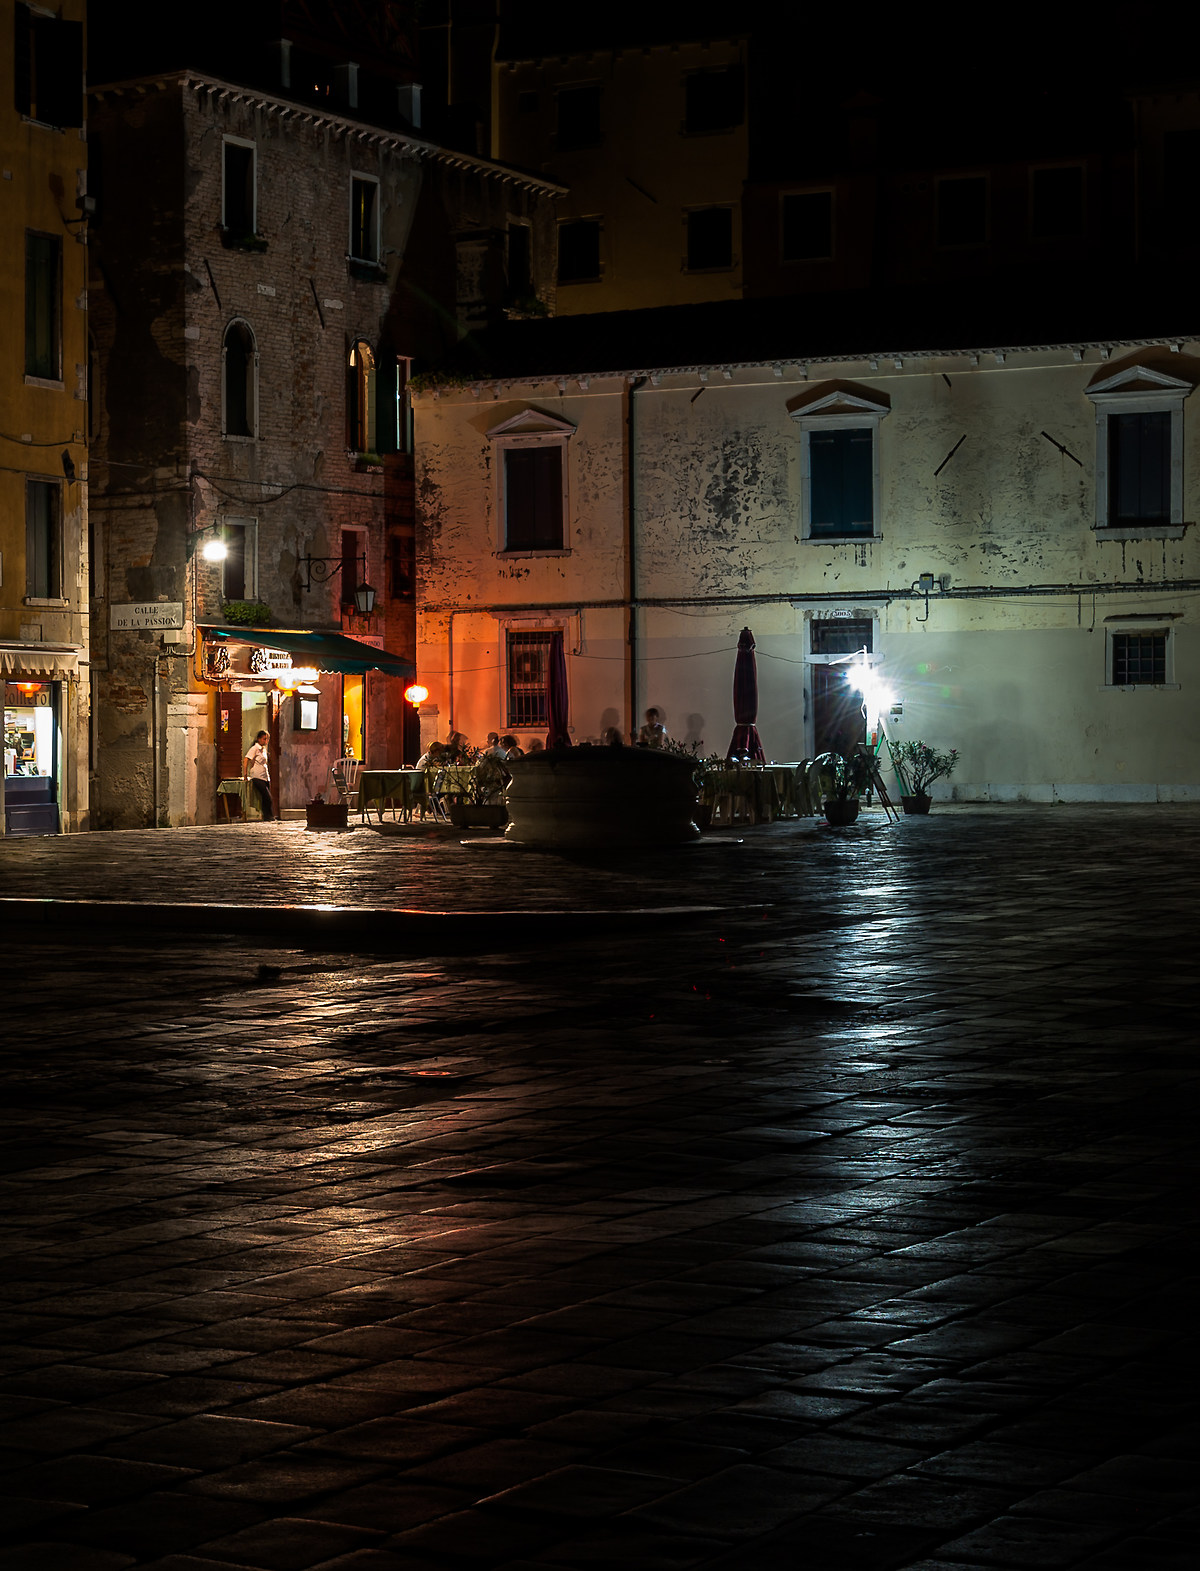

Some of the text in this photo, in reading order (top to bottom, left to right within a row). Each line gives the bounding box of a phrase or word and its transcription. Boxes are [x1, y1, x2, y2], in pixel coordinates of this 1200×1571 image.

[134, 606, 159, 615] CALLE
[117, 617, 176, 627] DE LA PASSION
